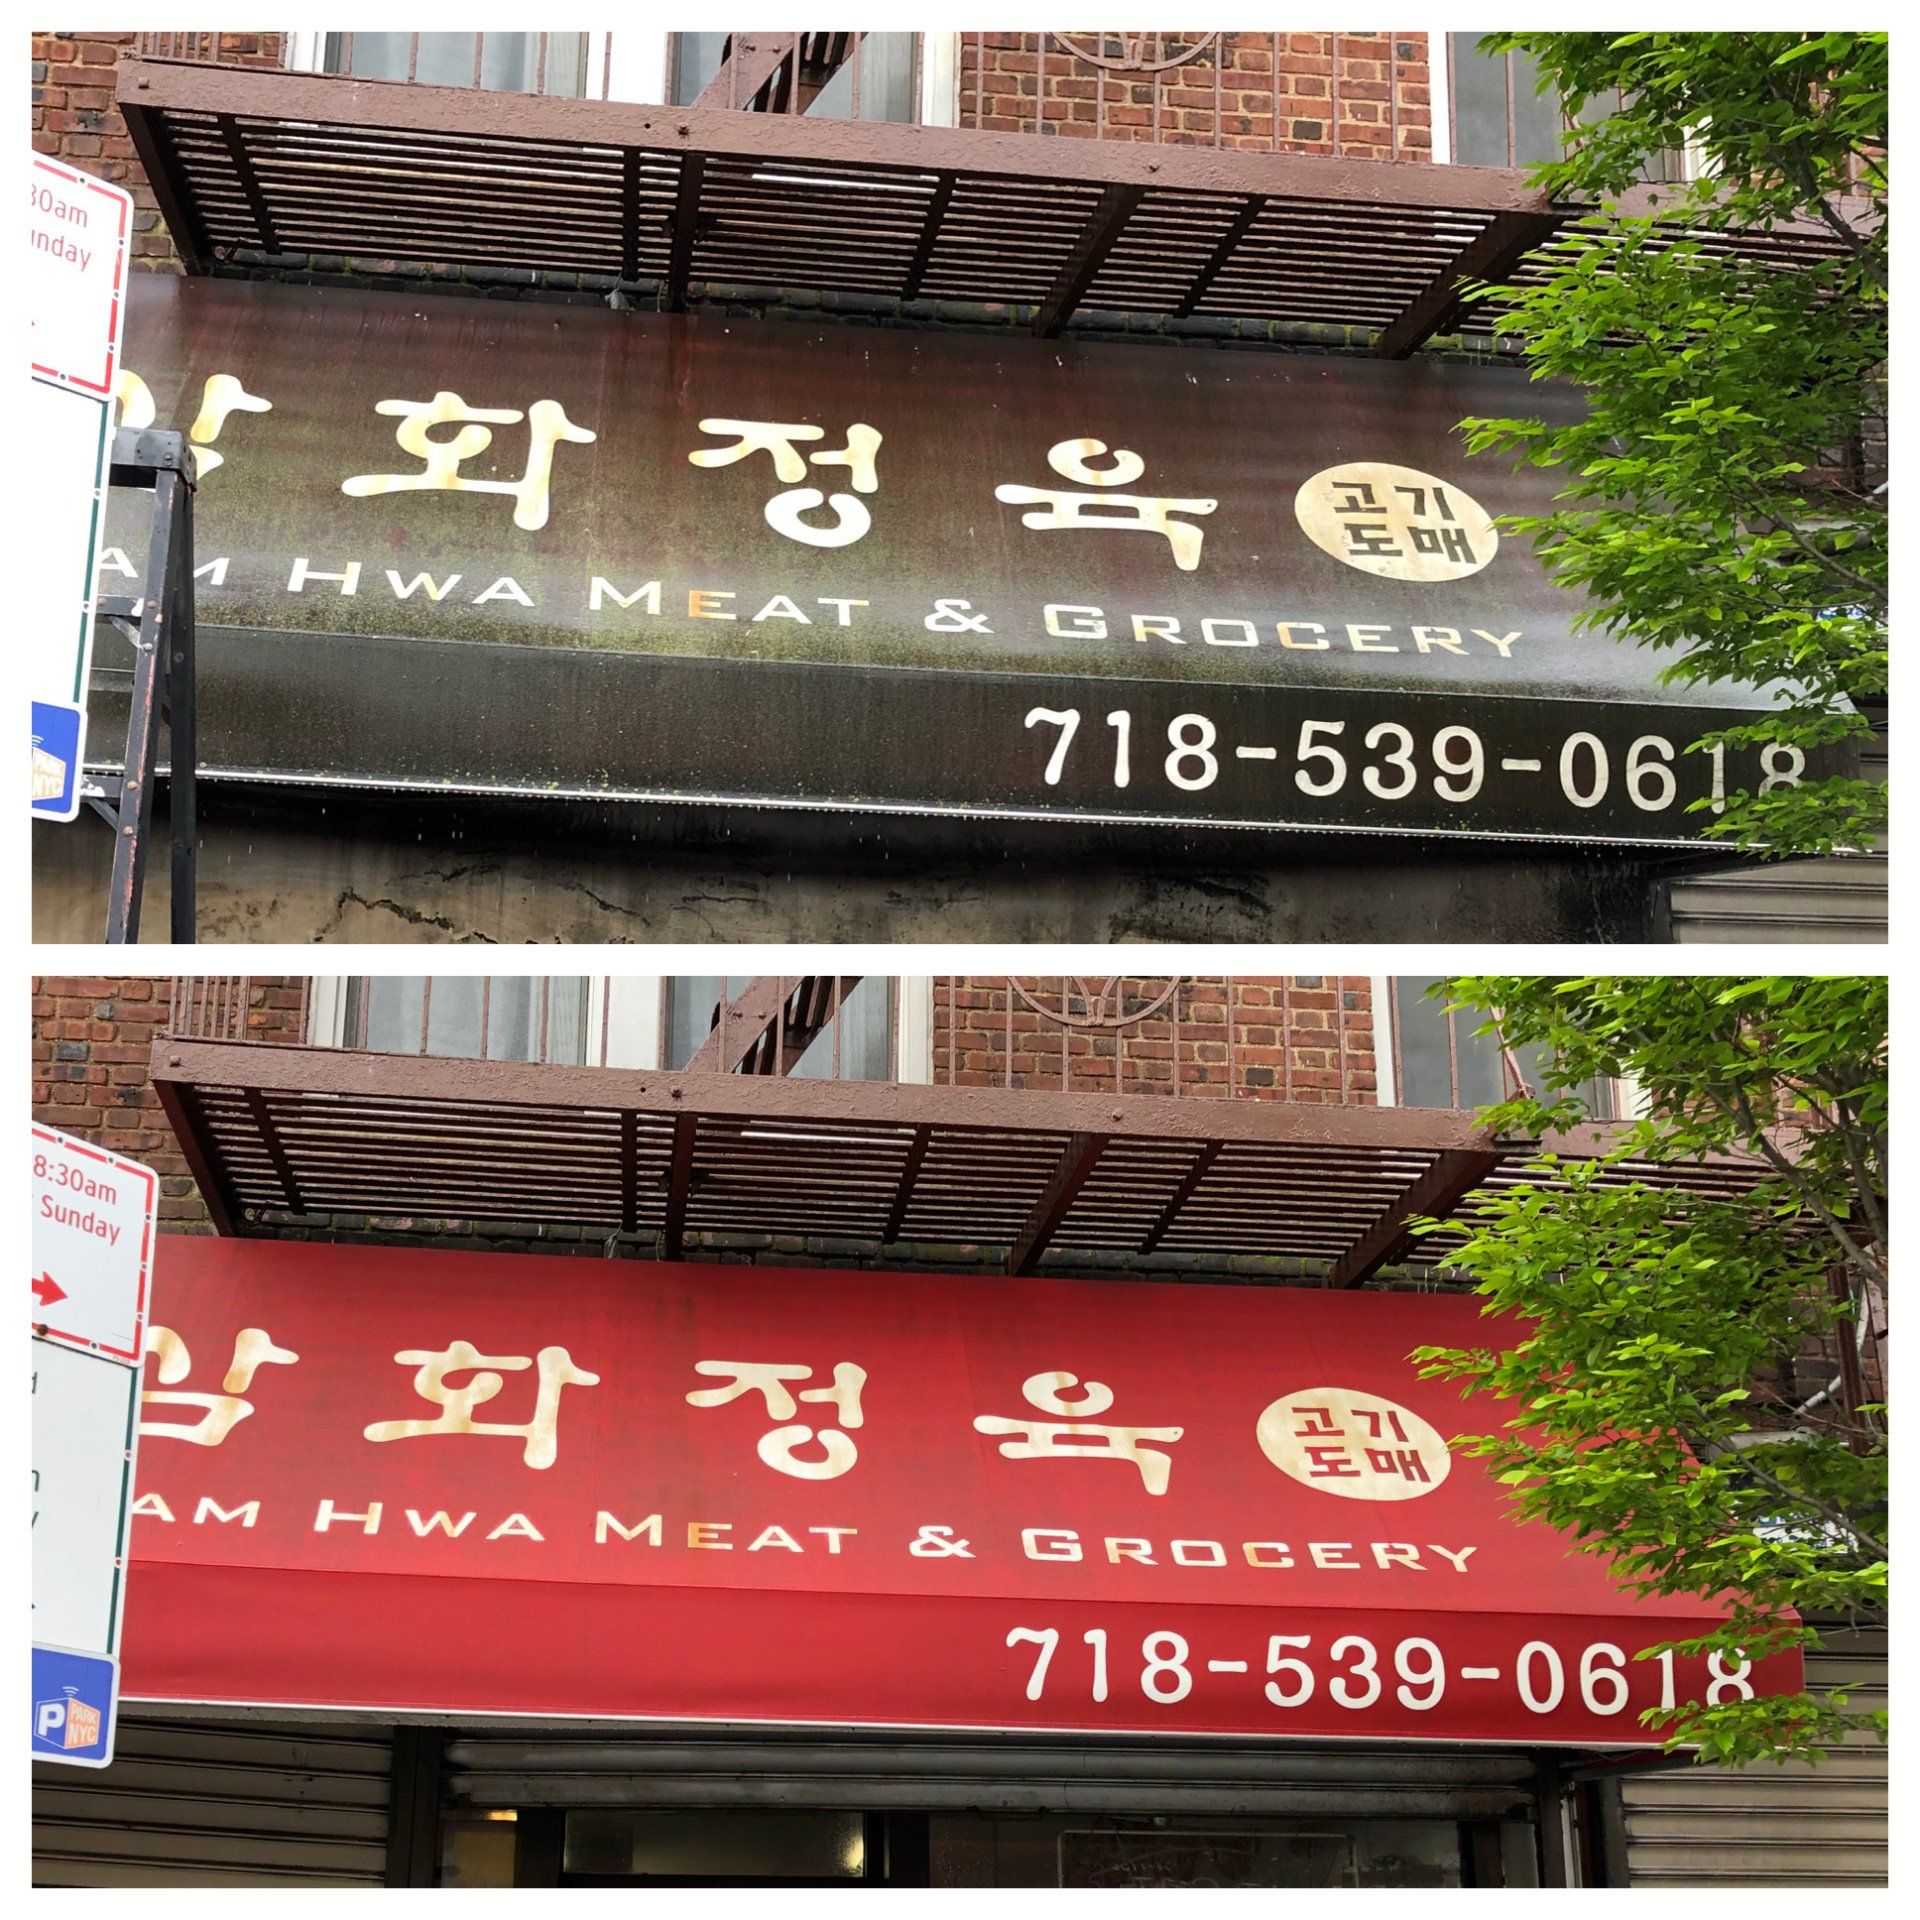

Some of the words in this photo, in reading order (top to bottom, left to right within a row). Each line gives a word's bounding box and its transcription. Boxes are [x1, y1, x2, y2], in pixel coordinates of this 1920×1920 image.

[1332, 481, 1455, 520] 고기
[1344, 523, 1477, 565] 도매
[287, 557, 536, 607] HWA
[589, 576, 870, 627] MEAT
[923, 598, 996, 634] &
[1042, 603, 1524, 658] GROCERY
[1024, 706, 1806, 814] 718-539-0618
[33, 1154, 117, 1205] 8:30am
[40, 1194, 121, 1246] Sunday
[1291, 1406, 1410, 1443] 고기
[1305, 1446, 1431, 1483] 도매
[313, 1499, 546, 1542] HWA
[594, 1510, 858, 1555] MEAT
[908, 1525, 977, 1558] &
[1021, 1528, 1478, 1573] GROCERY
[1005, 1627, 1755, 1716] 718-539-0618
[38, 1703, 66, 1737] P
[68, 1724, 97, 1745] NYC
